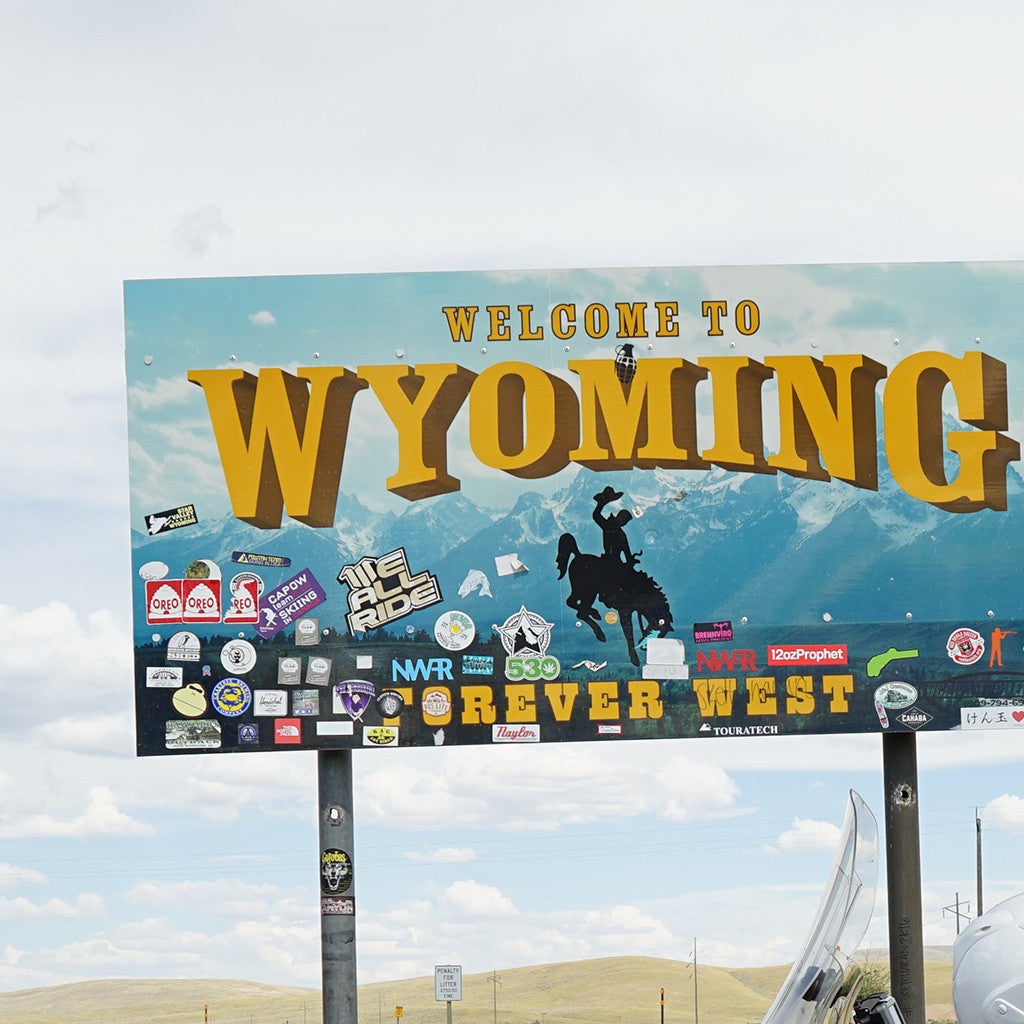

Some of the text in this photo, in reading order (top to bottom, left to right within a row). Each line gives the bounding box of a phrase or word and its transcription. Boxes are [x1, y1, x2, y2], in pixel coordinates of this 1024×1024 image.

[442, 300, 760, 342] WELCOME TO
[187, 350, 1022, 530] WYOMING
[169, 517, 197, 528] WYOMING
[171, 511, 194, 520] VALLEY
[268, 574, 307, 604] CAPOW
[351, 571, 428, 612] ALL
[152, 597, 252, 610] OREO OREO REO
[272, 595, 294, 610] team
[278, 590, 318, 620] SKIING
[350, 582, 438, 632] RIDE
[283, 616, 293, 625] IN
[771, 648, 844, 662] 12ozProphet
[692, 673, 855, 718] WEST
[901, 714, 927, 722] CANADA
[966, 711, 1008, 725] けん玉
[496, 725, 537, 740] Naylor
[713, 725, 778, 736] TOURATECH
